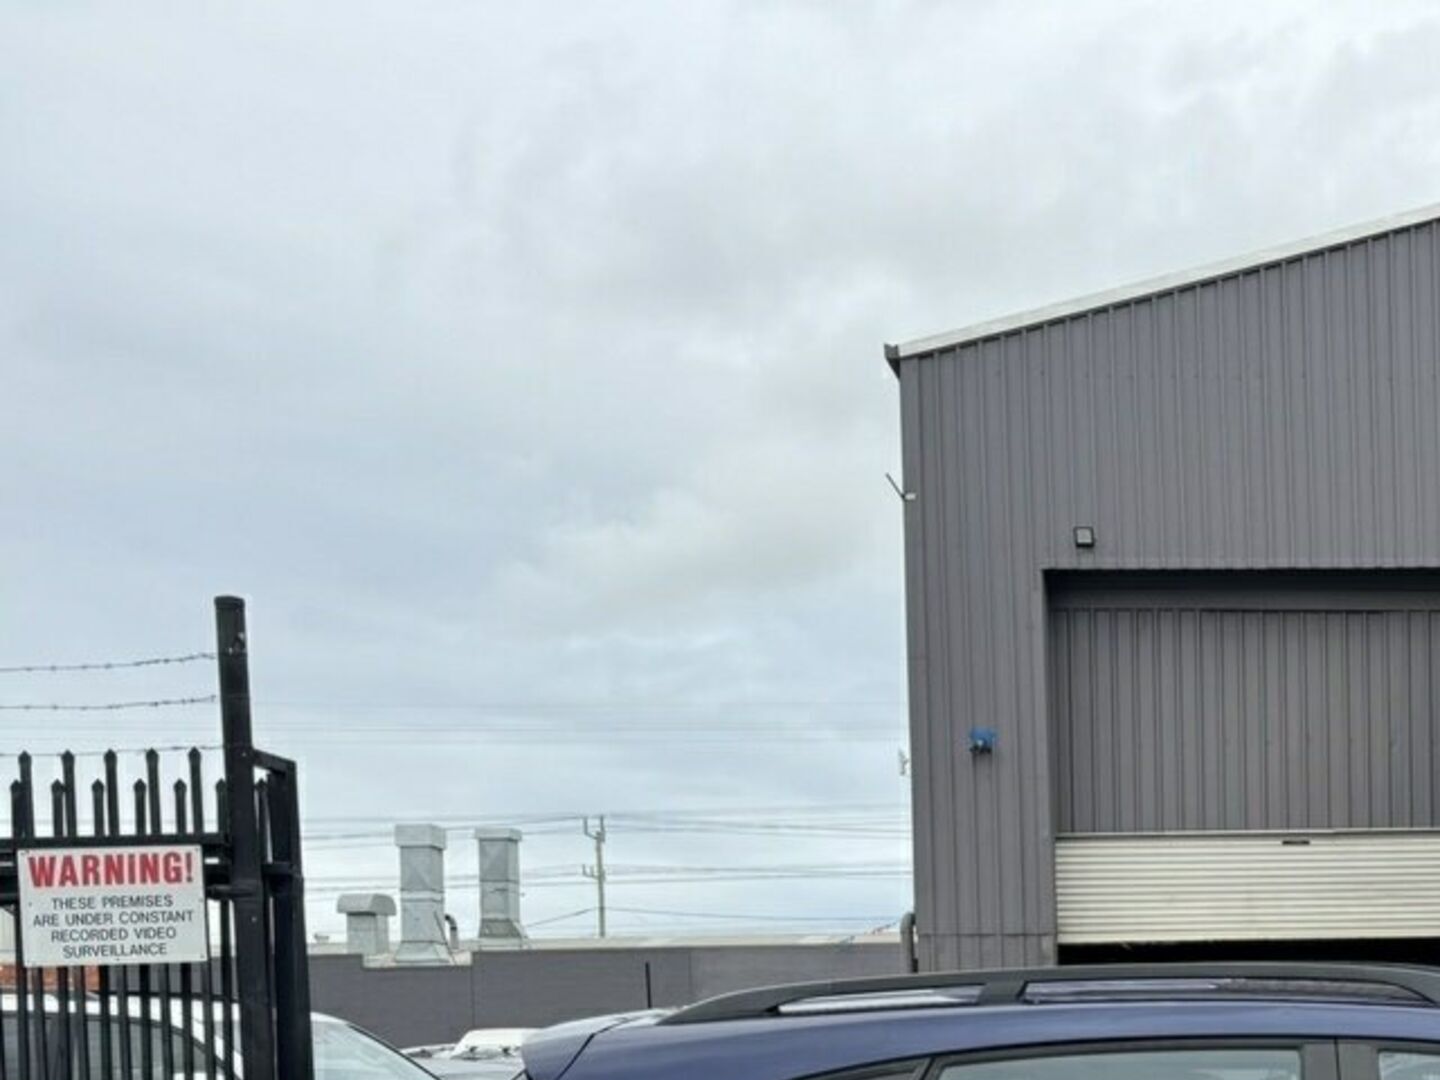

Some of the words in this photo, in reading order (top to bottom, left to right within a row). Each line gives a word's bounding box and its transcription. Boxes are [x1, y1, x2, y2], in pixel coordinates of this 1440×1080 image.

[28, 851, 193, 888] WARNING!
[52, 896, 96, 910] THESE
[102, 894, 174, 909] PREMISES
[33, 914, 59, 928] ARE
[64, 912, 113, 926] UNDER
[119, 910, 194, 924] CONSTANT
[51, 928, 129, 942] RECORDED
[134, 927, 177, 940] VIDEO
[62, 942, 168, 959] SURVEILLANCE
